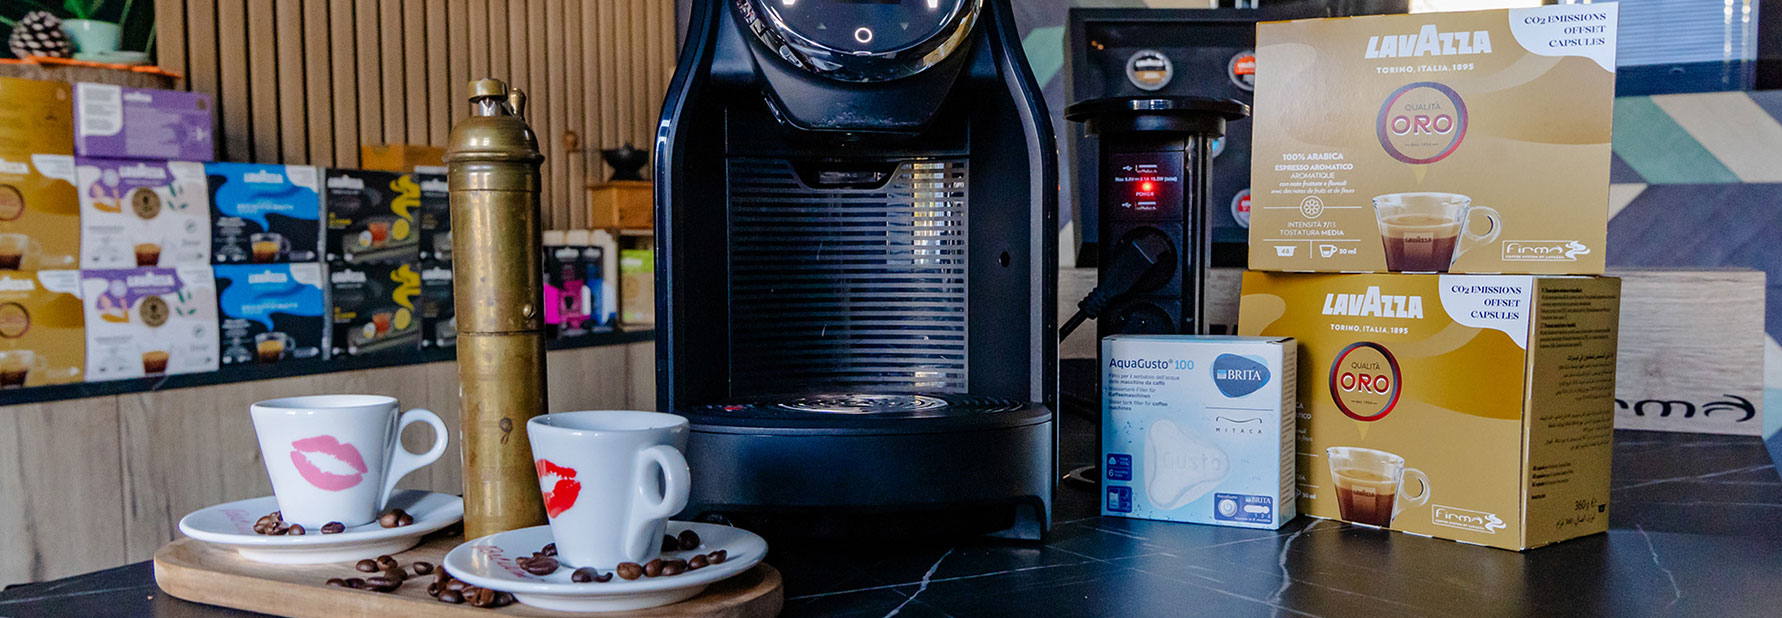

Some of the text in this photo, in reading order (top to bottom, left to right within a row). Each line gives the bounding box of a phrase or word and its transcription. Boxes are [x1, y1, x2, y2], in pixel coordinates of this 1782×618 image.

[1524, 12, 1607, 25] CO2 EMISSIONS
[1563, 25, 1607, 34] OFFSET
[1364, 24, 1492, 59] LAVAZZA
[1548, 37, 1606, 48] CAPSULES
[1452, 63, 1475, 71] 1895
[1391, 113, 1454, 136] ORO
[1282, 152, 1344, 161] 100% ARABICA
[1274, 163, 1354, 172] ESPRESSO AROMATICO
[1451, 285, 1522, 295] CO2 EMISSIONS
[1321, 286, 1424, 319] LAVAZZA
[1483, 298, 1521, 308] OFFSET
[1470, 310, 1520, 321] CAPSULES
[1390, 326, 1409, 335] 1895
[1175, 359, 1195, 370] 100
[1351, 361, 1380, 370] QUALITÀ
[1228, 369, 1262, 381] BRITA
[1340, 372, 1391, 395] ORO
[1251, 496, 1272, 504] BRITA
